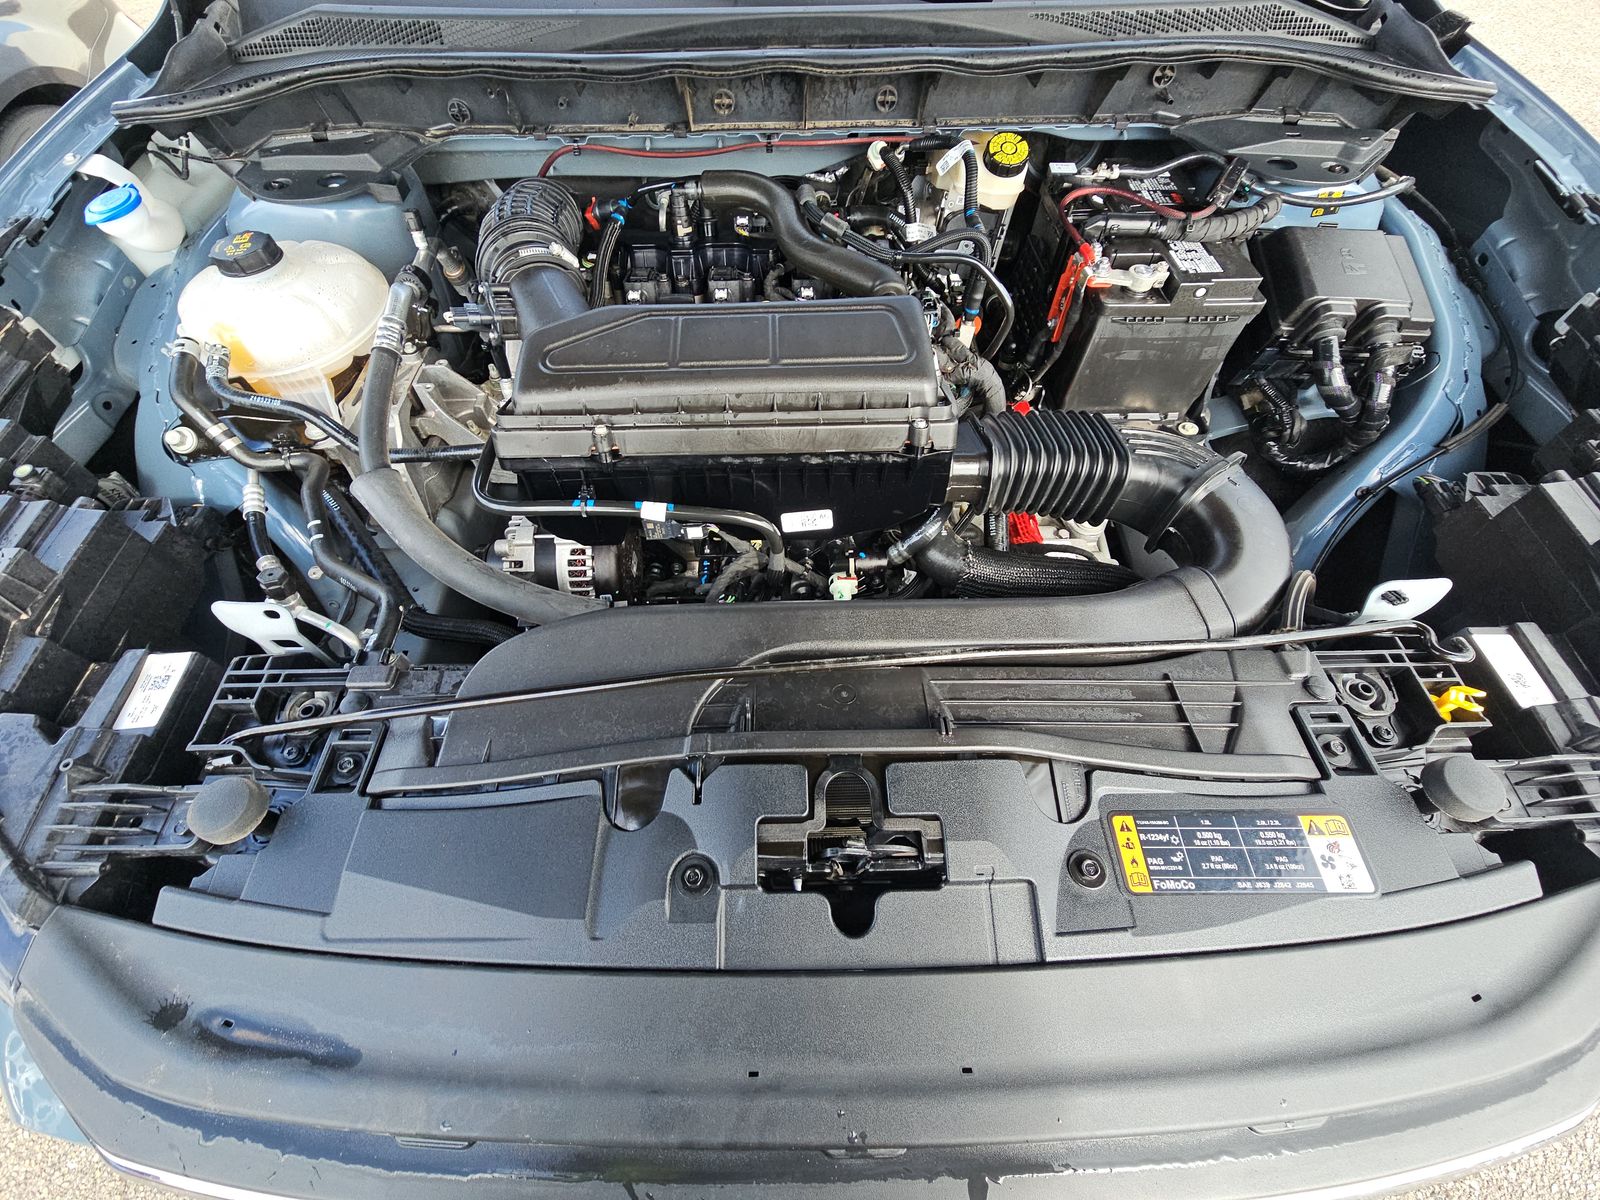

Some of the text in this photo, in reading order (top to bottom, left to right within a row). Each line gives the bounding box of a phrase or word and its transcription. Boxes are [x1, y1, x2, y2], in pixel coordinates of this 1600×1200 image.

[1139, 833, 1170, 842] R-1234yf
[1147, 857, 1164, 865] PAG
[1152, 880, 1196, 890] FoMoCo
